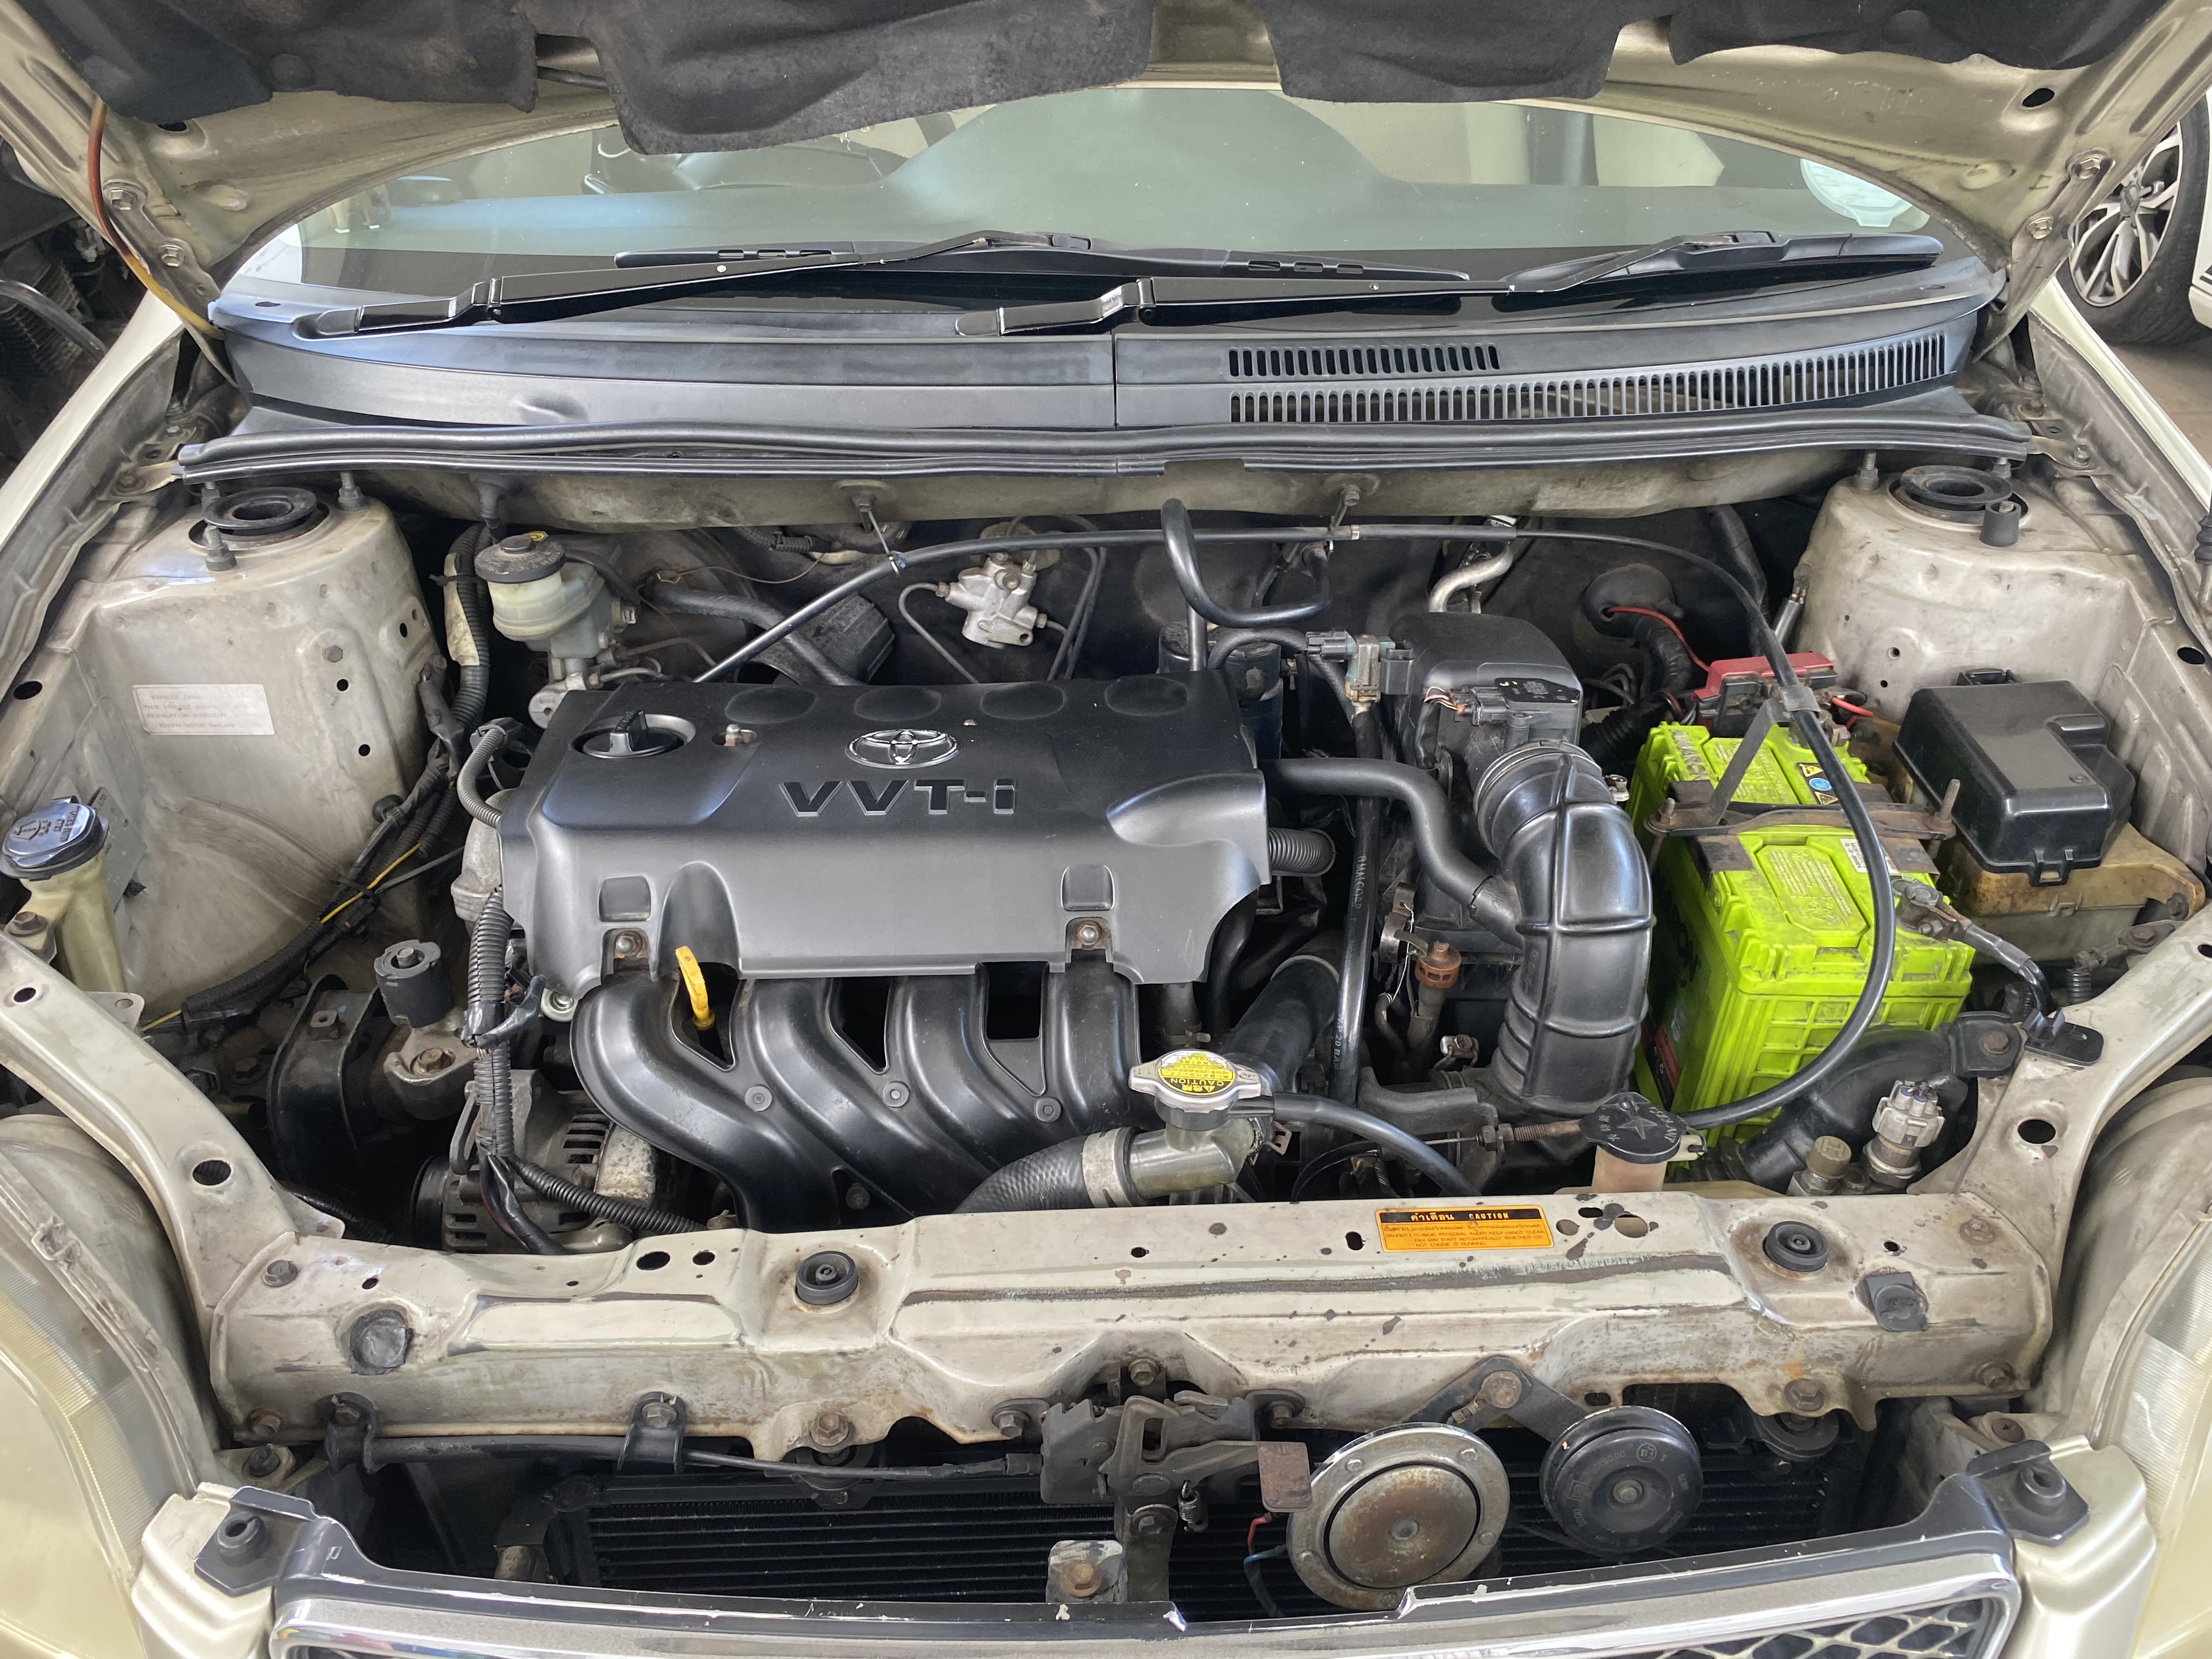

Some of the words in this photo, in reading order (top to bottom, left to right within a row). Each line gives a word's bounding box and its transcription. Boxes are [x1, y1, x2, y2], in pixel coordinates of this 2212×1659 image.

[779, 778, 1018, 817] VVT-i
[1335, 1035, 1341, 1046] 20
[1170, 1078, 1224, 1086] CAUTION
[1649, 1106, 1678, 1144] COOLANT
[1822, 1138, 1844, 1157] H
